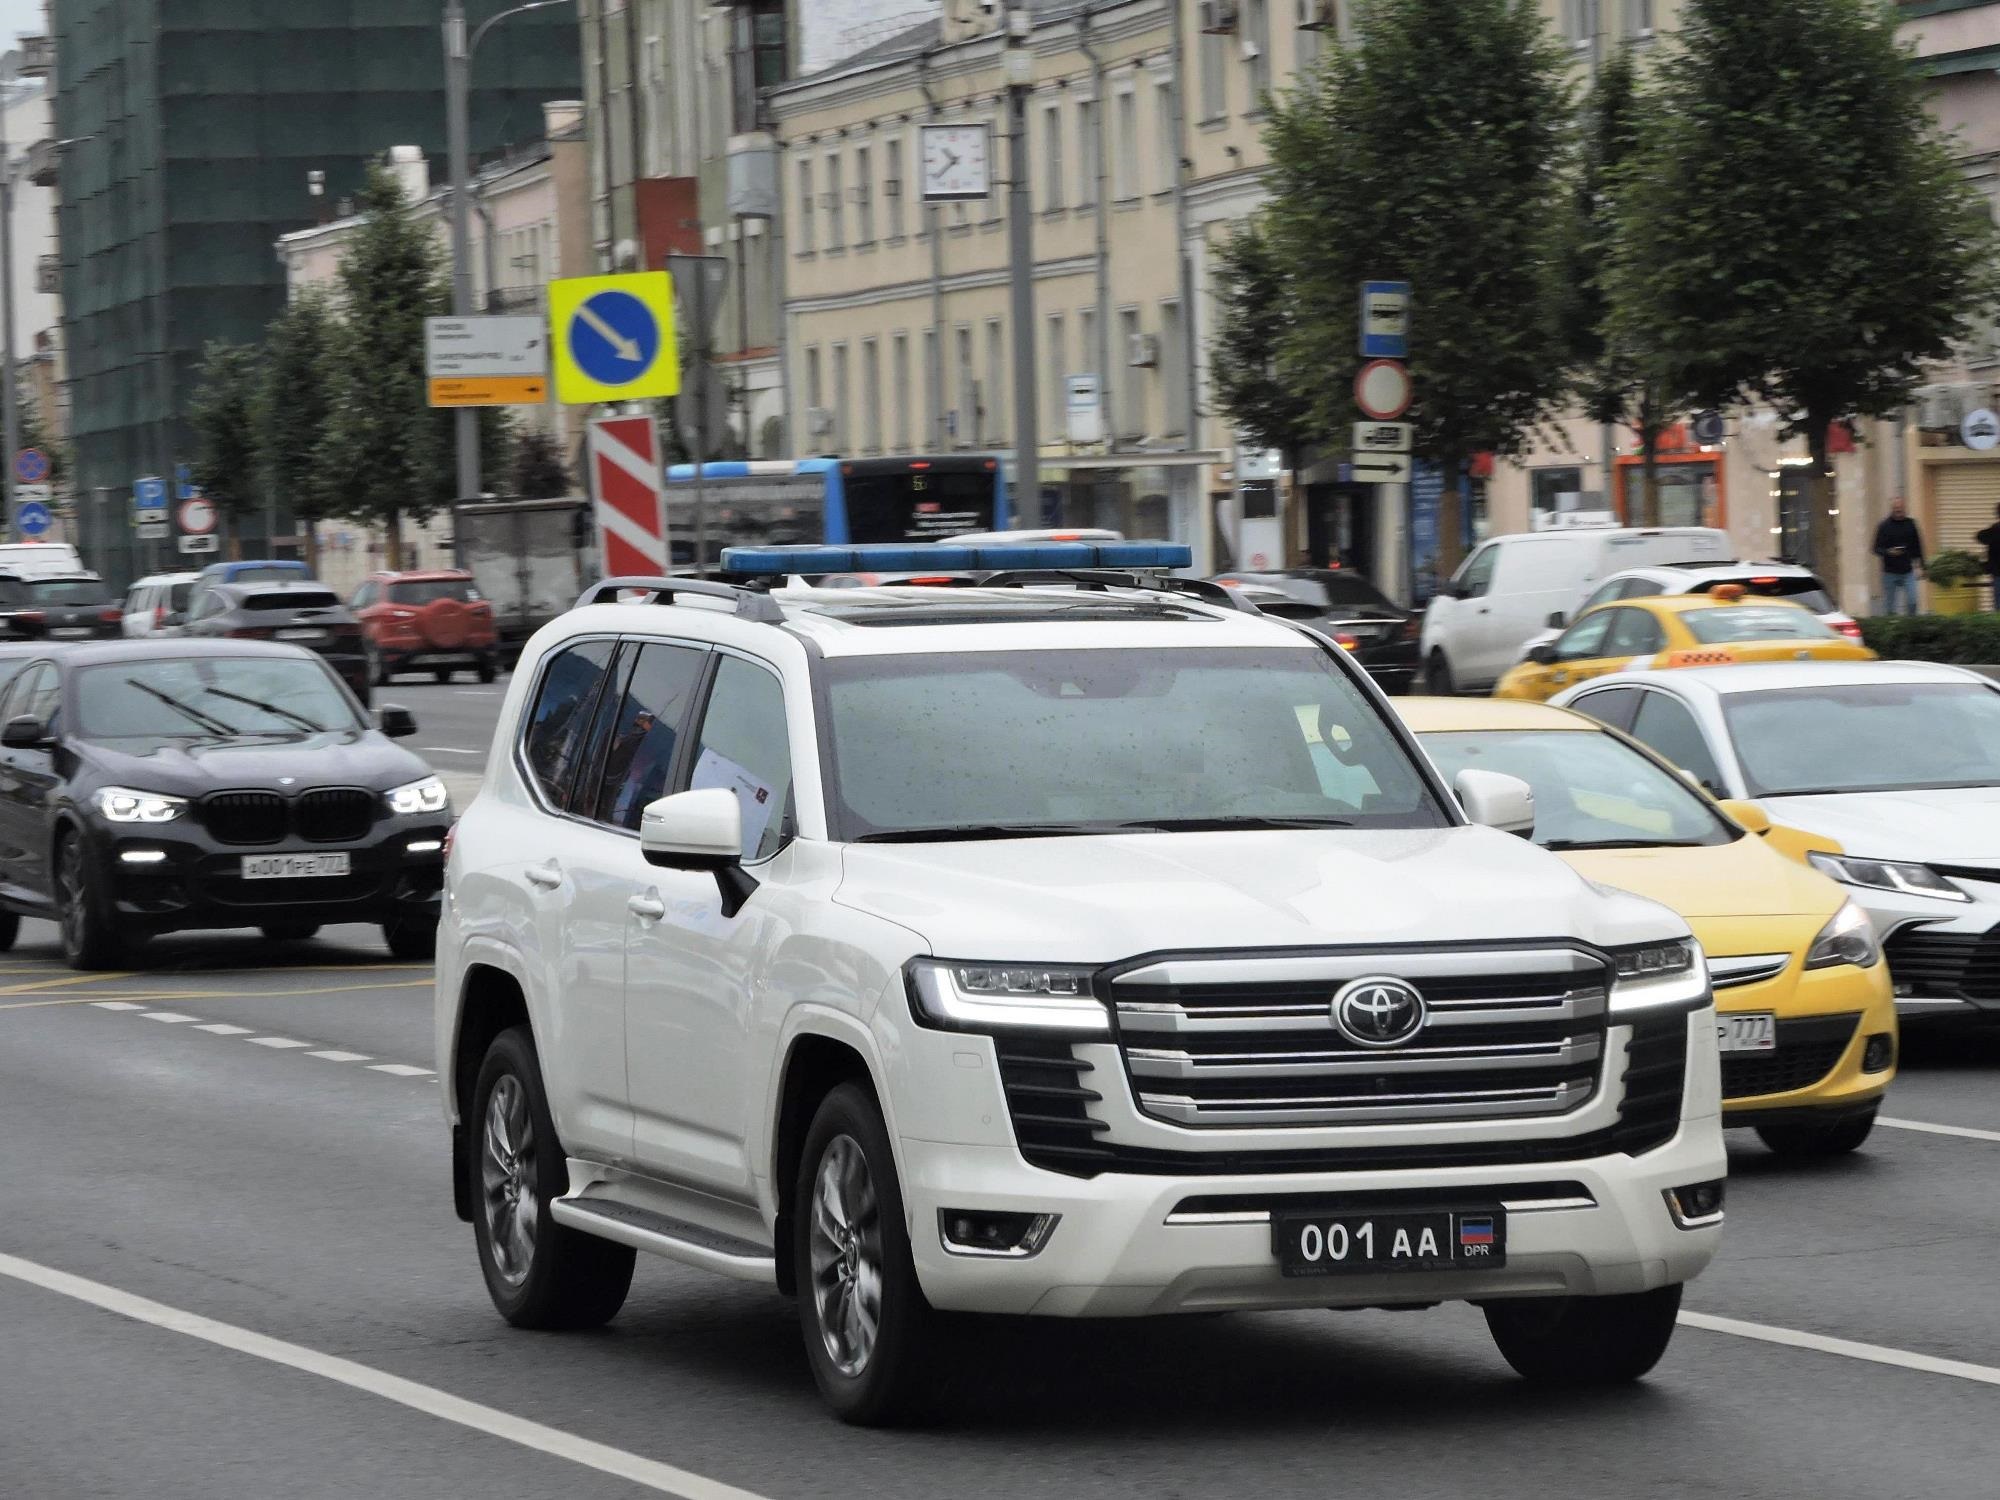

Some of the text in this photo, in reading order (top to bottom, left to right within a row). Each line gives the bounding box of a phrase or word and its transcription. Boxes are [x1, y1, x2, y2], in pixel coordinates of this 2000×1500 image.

[1301, 1221, 1438, 1261] 001 AA
[1463, 1245, 1489, 1257] DPR
